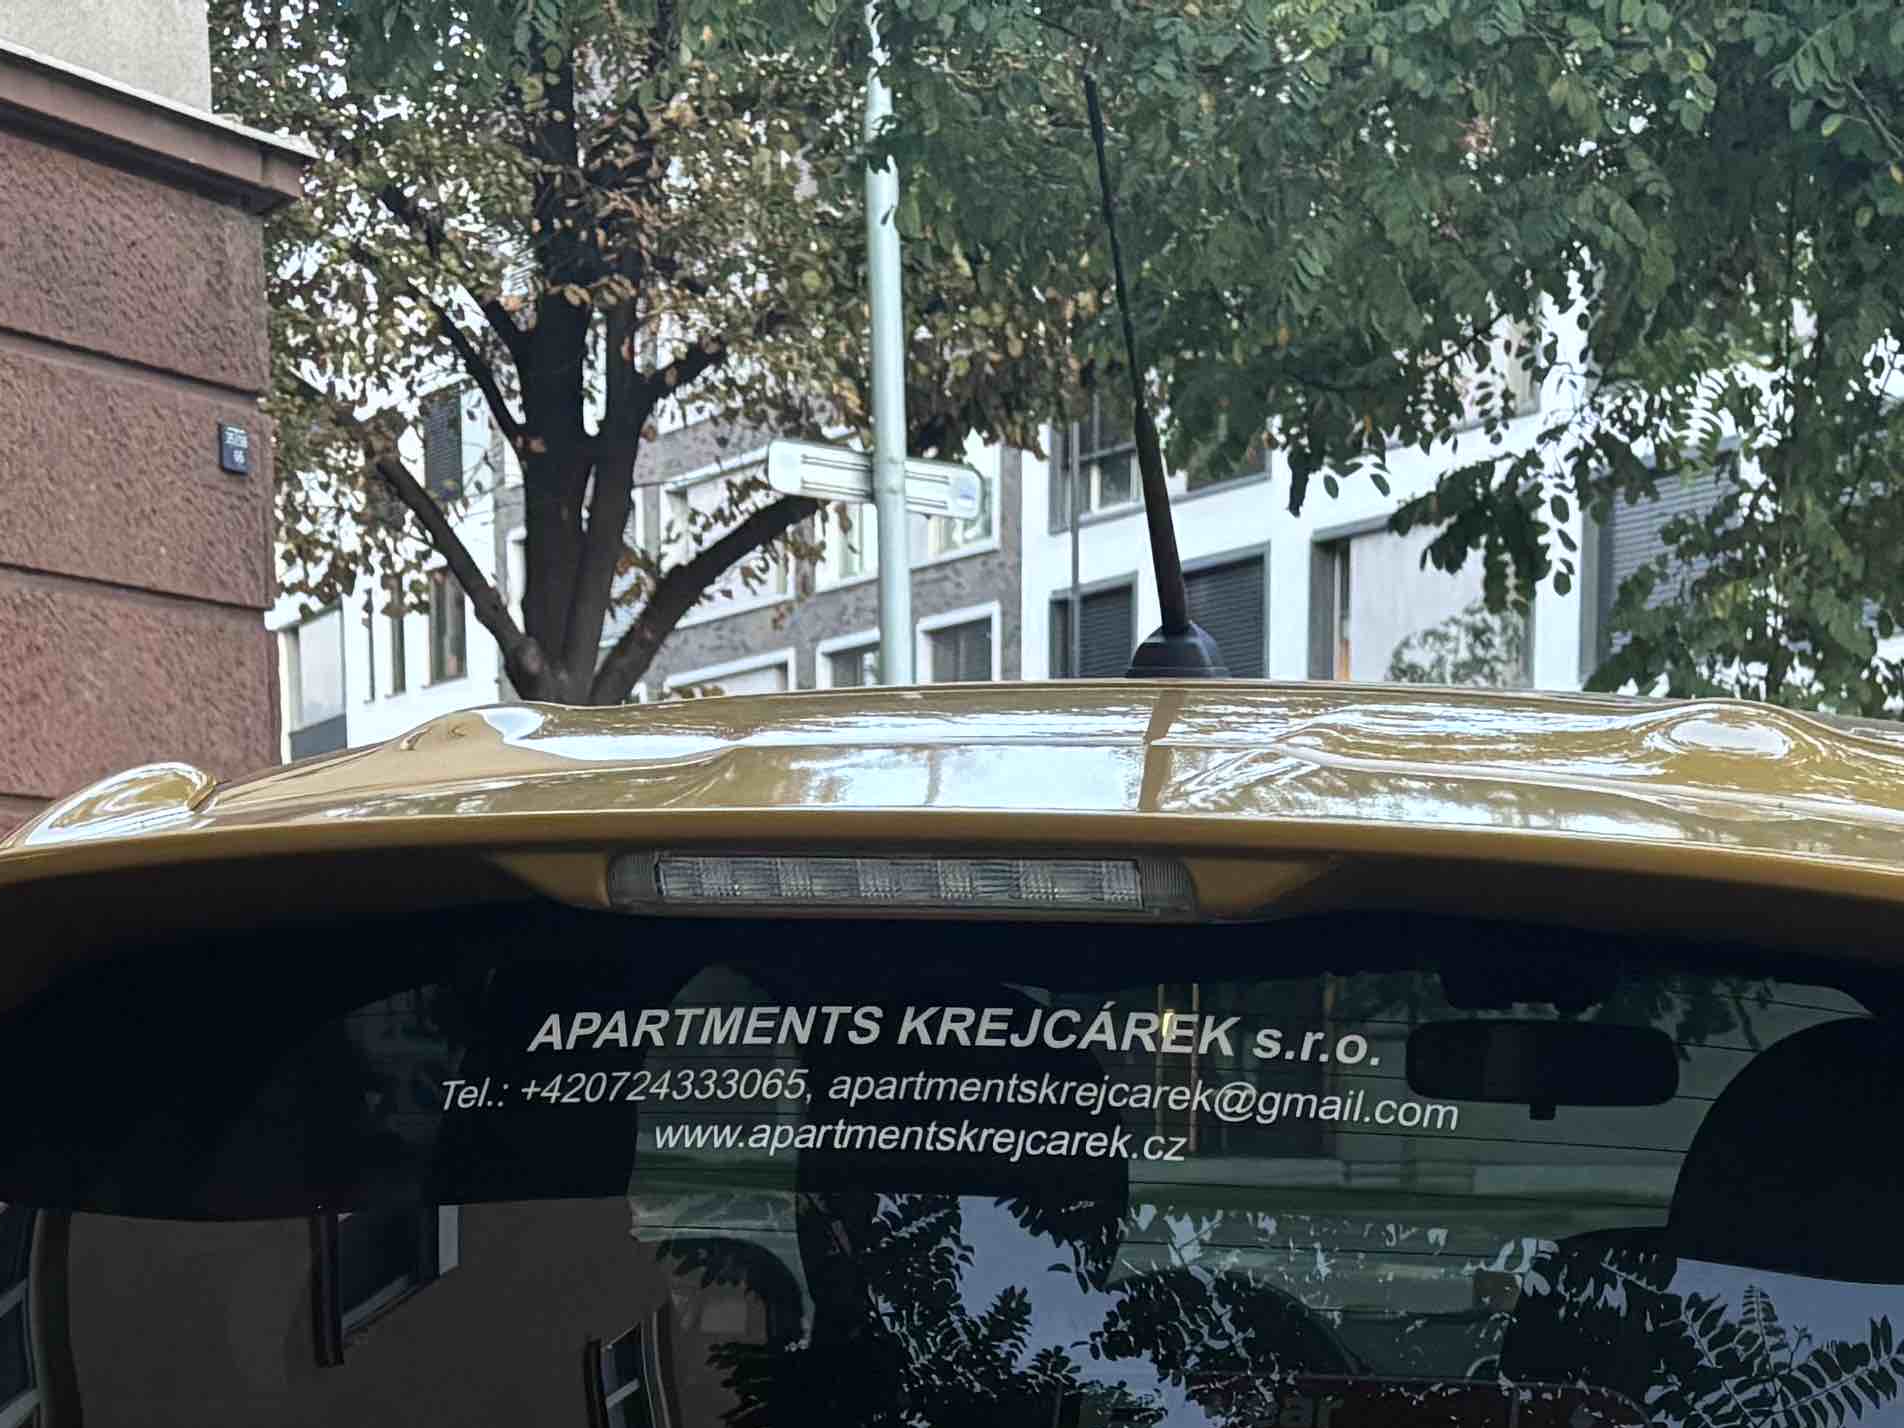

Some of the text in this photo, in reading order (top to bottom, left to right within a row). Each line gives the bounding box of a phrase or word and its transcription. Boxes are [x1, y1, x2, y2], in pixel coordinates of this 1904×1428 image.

[526, 1000, 1381, 1067] APARTMENTS KREJCÁREK s.r.o.
[439, 1067, 1459, 1130] Tel.: +420724333065, apartmentskrejcarek@gmail.com
[653, 1117, 1187, 1163] www.apartmentskrejcarek.cz
